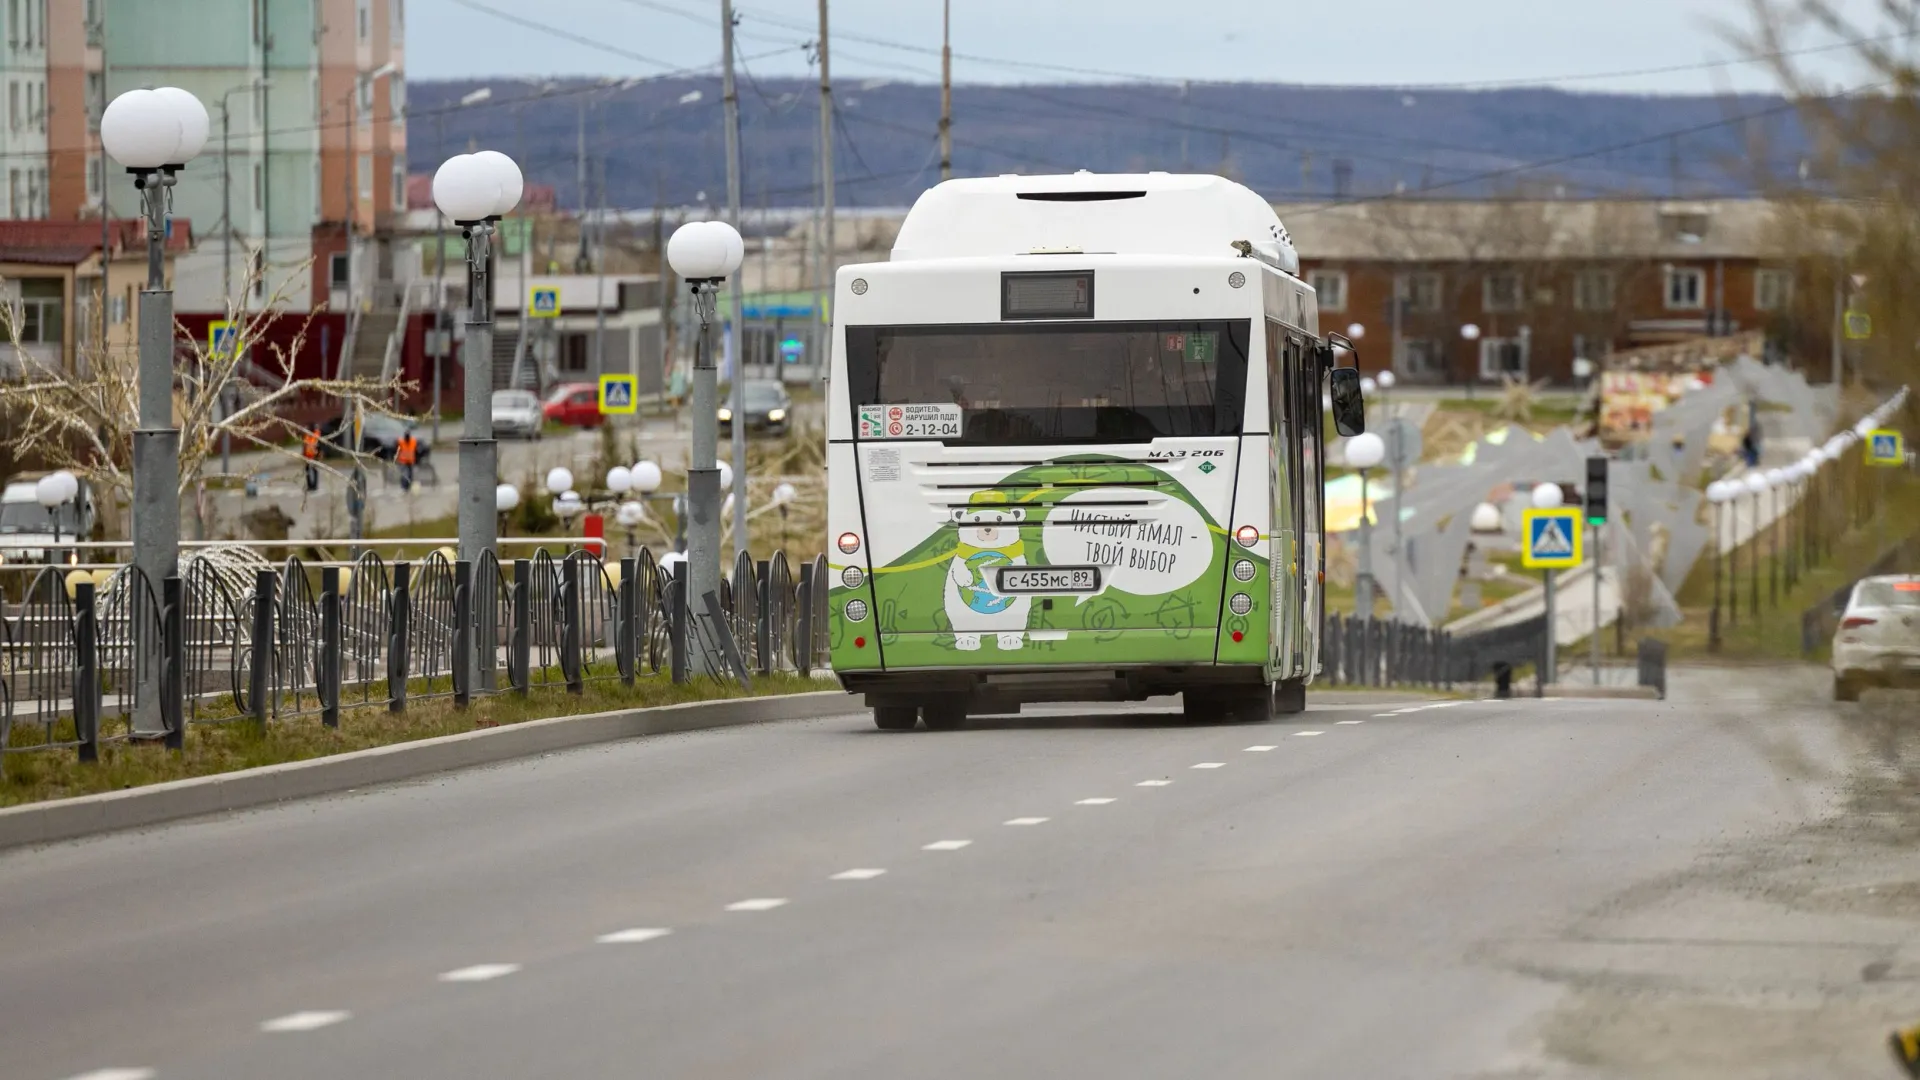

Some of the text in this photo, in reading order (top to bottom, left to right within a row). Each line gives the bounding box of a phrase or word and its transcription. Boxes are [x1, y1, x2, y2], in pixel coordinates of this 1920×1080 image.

[940, 413, 958, 421] ПДД?
[906, 423, 958, 435] 2-12-04
[1137, 523, 1183, 546] ЯМАЛ
[1086, 541, 1176, 574] ТВОЙ ВЫБОР
[1073, 571, 1088, 583] 89
